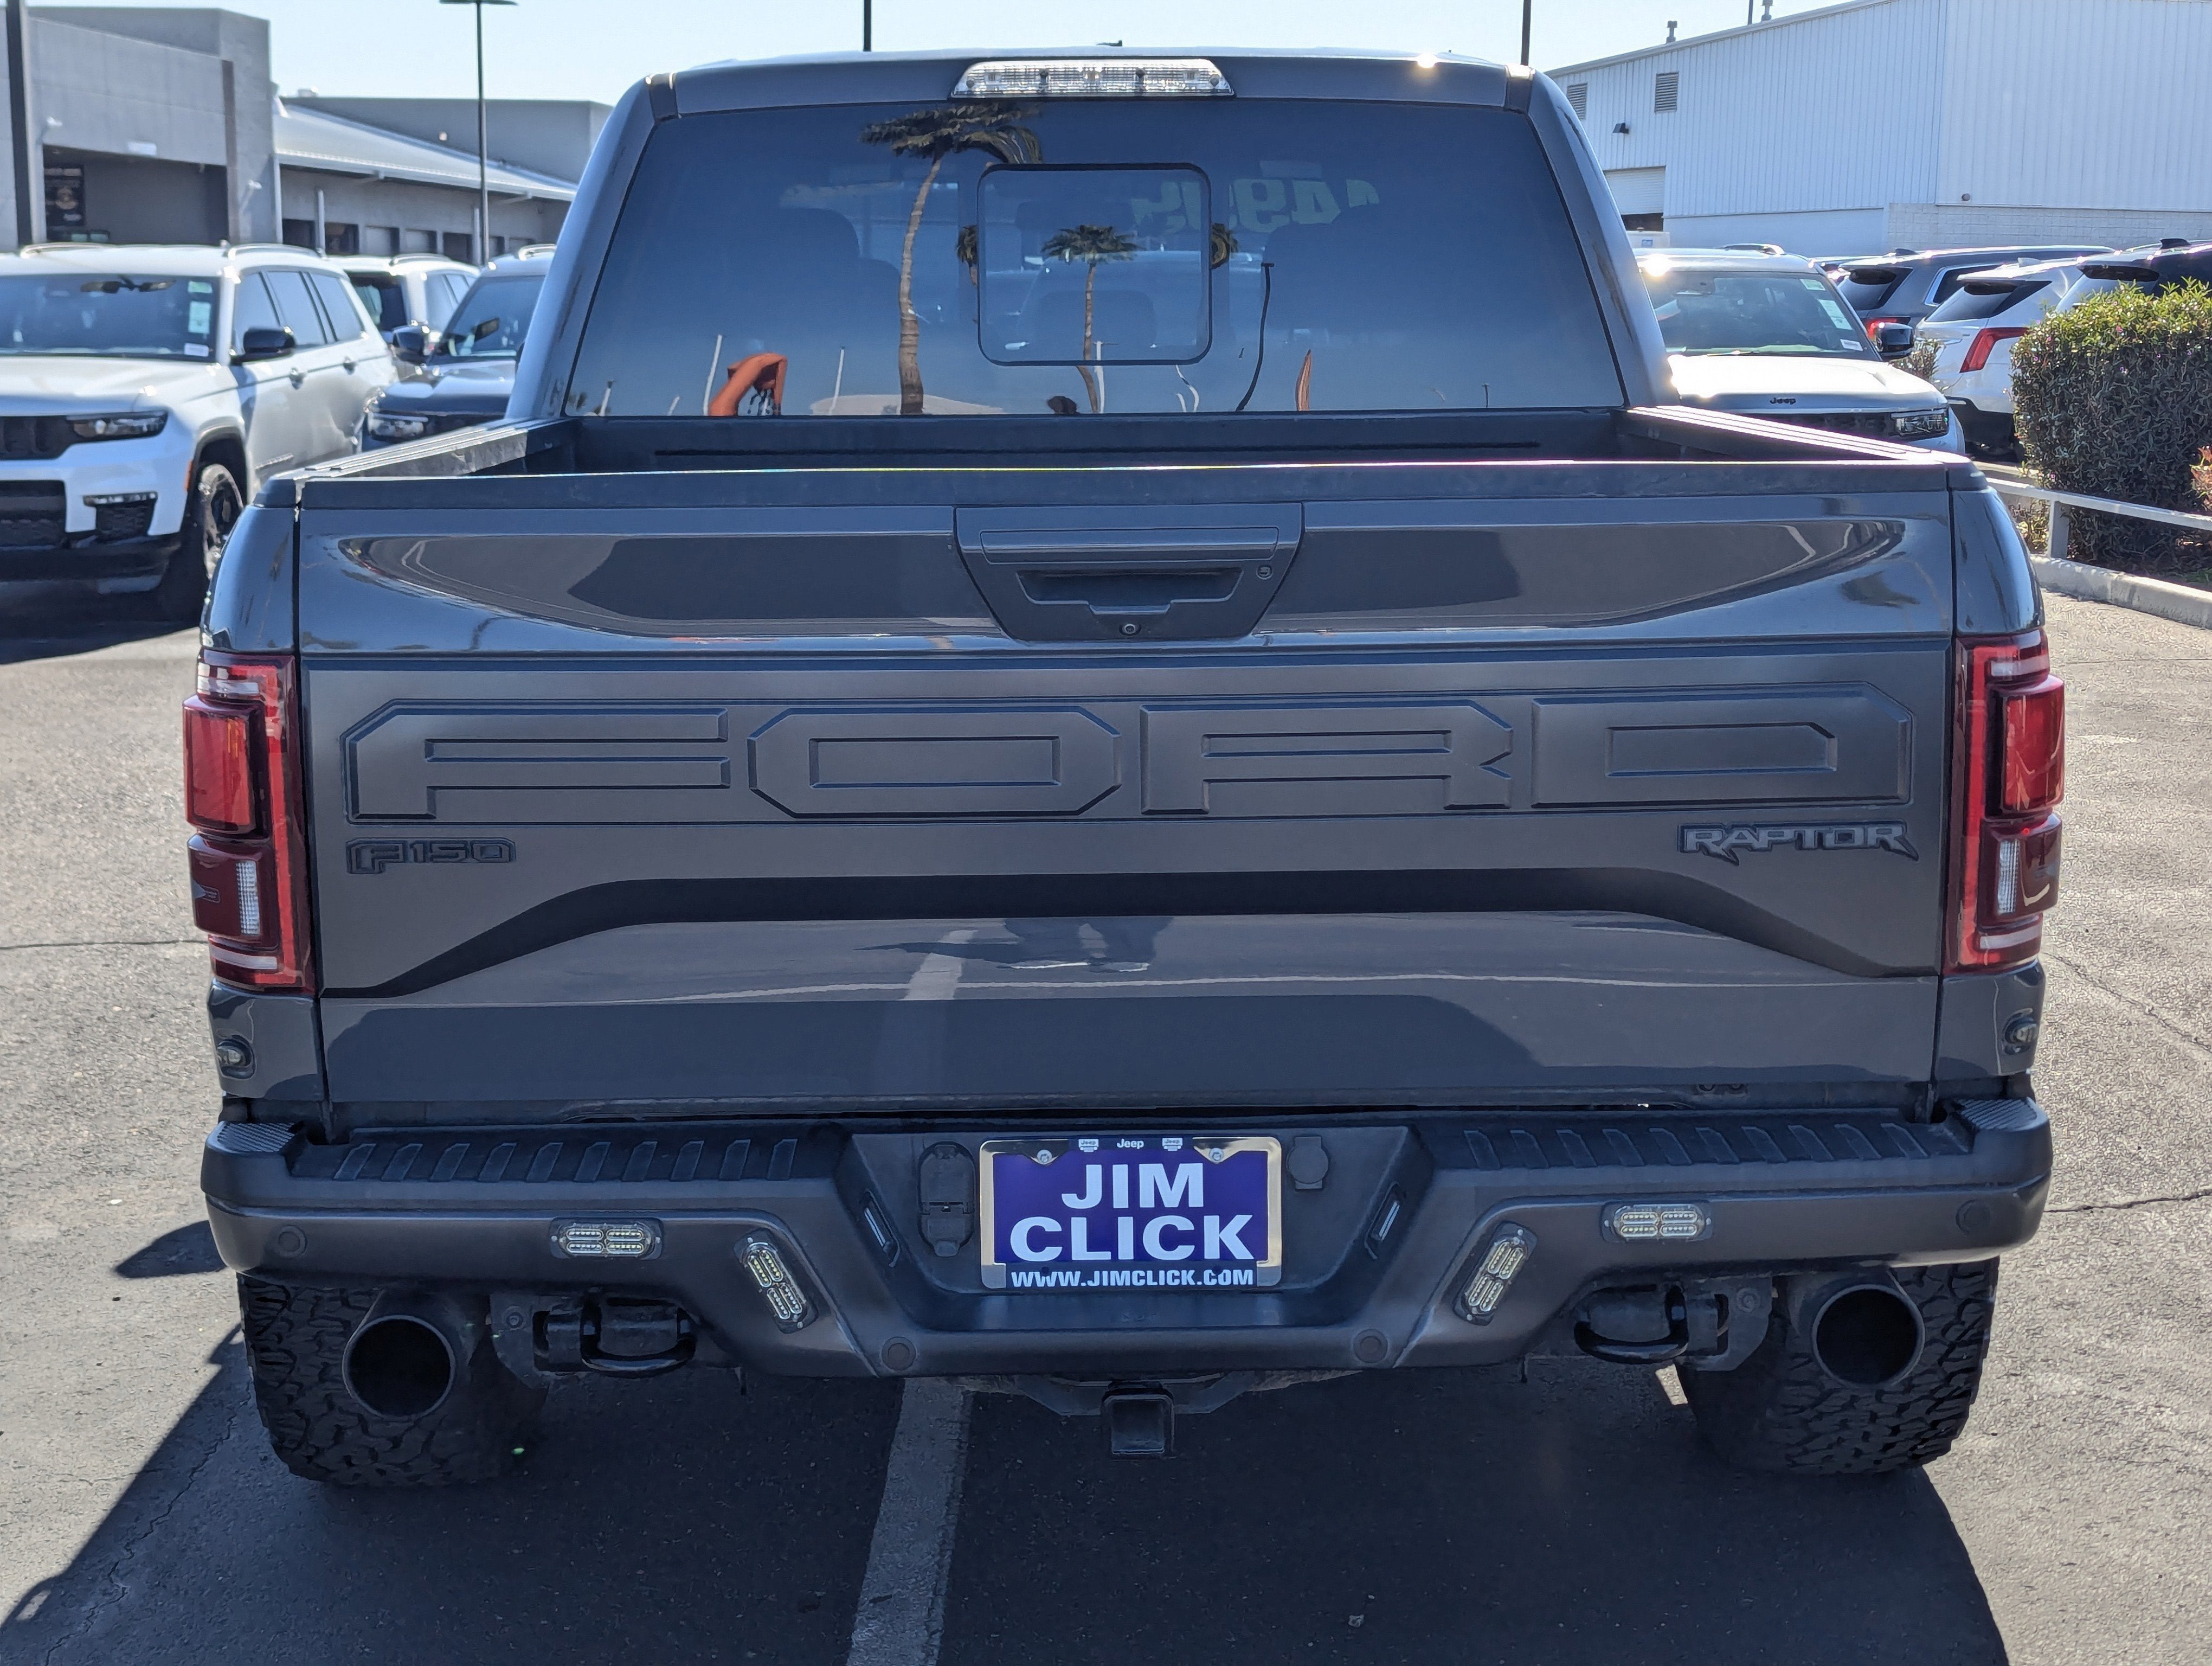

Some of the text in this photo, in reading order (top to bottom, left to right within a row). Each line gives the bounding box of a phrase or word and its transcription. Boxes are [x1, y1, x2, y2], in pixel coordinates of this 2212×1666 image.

[1769, 397, 1796, 405] Jeep
[347, 689, 1908, 820] FORD
[1679, 821, 1919, 866] RAPTOR
[1116, 1138, 1144, 1149] Jeep
[1061, 1163, 1204, 1209] JIM
[1009, 1214, 1254, 1261] CLICK
[1011, 1268, 1253, 1287] WWW.JIMCLICK.COM
